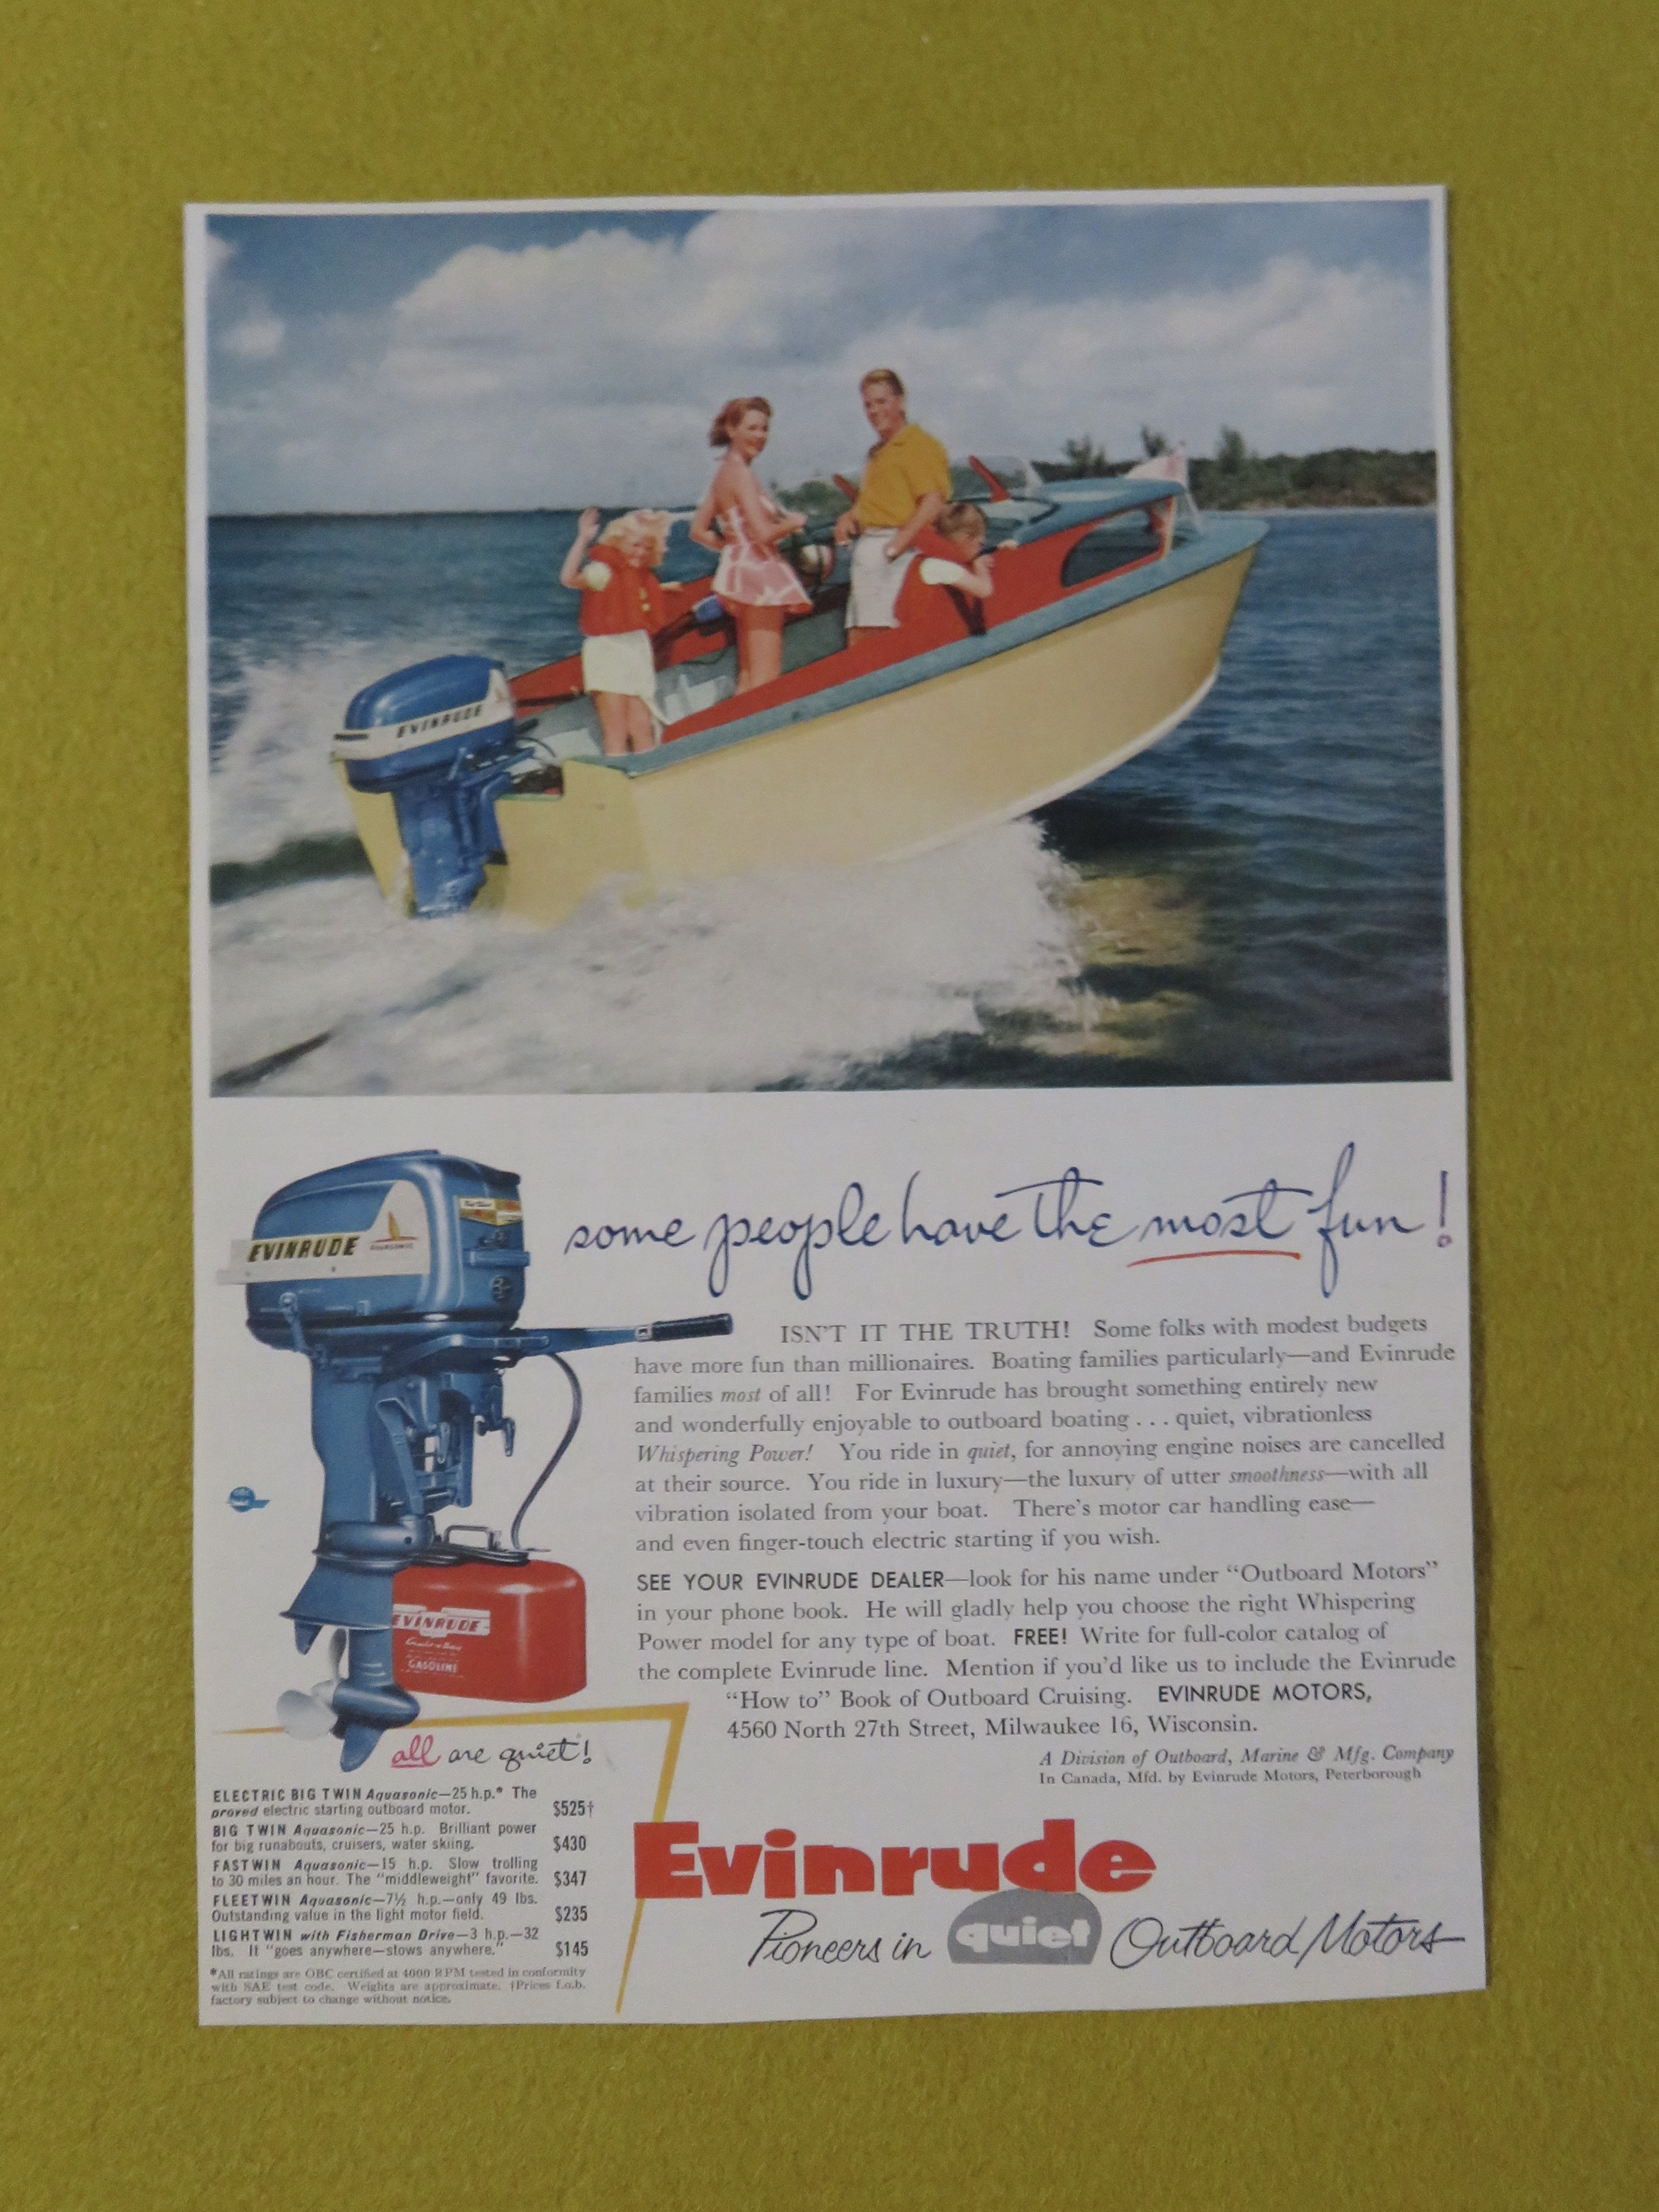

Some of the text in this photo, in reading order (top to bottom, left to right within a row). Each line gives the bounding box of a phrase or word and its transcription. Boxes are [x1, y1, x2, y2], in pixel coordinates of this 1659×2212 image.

[564, 1218, 695, 1255] some
[703, 1182, 891, 1300] people
[902, 1171, 1022, 1246] have
[995, 1166, 1140, 1247] the
[1139, 1179, 1313, 1240] most
[248, 1236, 360, 1263] EVINRUDE
[860, 1323, 888, 1342] IT
[899, 1322, 953, 1341] THE
[965, 1320, 1070, 1340] TRUTH!
[1094, 1318, 1151, 1338] Some
[1159, 1318, 1206, 1336] folks
[1212, 1316, 1258, 1335] with
[1266, 1315, 1339, 1334] modest
[1347, 1314, 1427, 1334] budgets
[634, 1356, 682, 1374] have
[691, 1361, 743, 1373] more
[751, 1355, 784, 1373] fun
[794, 1355, 840, 1372] than
[848, 1352, 974, 1371] millionaires.
[992, 1351, 1072, 1372] Boating
[1079, 1349, 1159, 1368] families
[1359, 1342, 1455, 1362] Evinrude
[634, 1403, 1372, 1437] and wonderfully enjoyable to outboard boating quiet, vibrationless
[638, 1443, 814, 1468] Whispering Power!
[637, 1573, 671, 1592] SEE
[683, 1572, 744, 1591] YOUR
[756, 1571, 859, 1590] EVINRUDE
[1020, 1568, 1049, 1586] for
[1057, 1567, 1086, 1585] his
[1094, 1571, 1151, 1585] name
[1159, 1564, 1219, 1584] under
[392, 1614, 481, 1632] EVINRUDE
[638, 1662, 670, 1680] the
[677, 1661, 772, 1685] complete
[781, 1660, 876, 1679] Evinrude
[884, 1659, 928, 1677] line.
[946, 1657, 1034, 1677] Mention
[1043, 1656, 1059, 1675] if
[1131, 1655, 1168, 1674] like
[1176, 1660, 1198, 1673] us
[1206, 1658, 1227, 1672] to
[1235, 1652, 1310, 1672] include
[1319, 1652, 1351, 1671] the
[1360, 1649, 1456, 1670] Evinrude
[840, 1689, 892, 1708] Book
[899, 1688, 921, 1707] of
[927, 1687, 1029, 1707] Outboard
[1038, 1686, 1132, 1709] Cruising.
[1158, 1683, 1260, 1703] EVINRUDE
[1272, 1681, 1372, 1703] MOTORS,
[727, 1714, 1257, 1740] 4560 North 27th Street, Milwaukee 16, Wisconsin.
[391, 1734, 592, 1772] all are quiet!
[1039, 1745, 1455, 1769] A Division of Outboard, Marine & Mfg. Company
[1039, 1766, 1421, 1786] In Canada, Mfd. by Evinrude Motors, Peterborough
[213, 1787, 286, 1802] ELECTRIC
[290, 1787, 316, 1801] BIG
[322, 1787, 362, 1800] TWIN
[512, 1785, 537, 1799] The
[211, 1802, 471, 1819] proved electric starting outboard motor.
[213, 1823, 238, 1837] BIG
[246, 1823, 287, 1837] TWIN
[401, 1822, 425, 1837] h.p.
[439, 1821, 491, 1834] Brilliant
[498, 1823, 537, 1837] power
[553, 1835, 587, 1854] $430
[214, 1858, 281, 1872] FASTWIN
[409, 1857, 432, 1872] h.p.
[449, 1856, 480, 1870] Slow
[492, 1856, 538, 1872] trolling
[634, 1819, 1157, 1899] Evinrude
[554, 1870, 587, 1888] $347
[214, 1893, 291, 1907] FLEETWIN
[492, 1891, 507, 1905] 49
[515, 1891, 538, 1905] lbs.
[212, 1906, 484, 1924] Outstanding value in the light motor field.
[555, 1905, 588, 1923] $235
[214, 1928, 292, 1942] LIGHTWIN
[300, 1929, 330, 1941] with
[335, 1929, 412, 1942] Fisherman
[748, 1909, 1465, 1969] Pioneers in quiet Outboard Motors
[556, 1940, 588, 1958] $145
